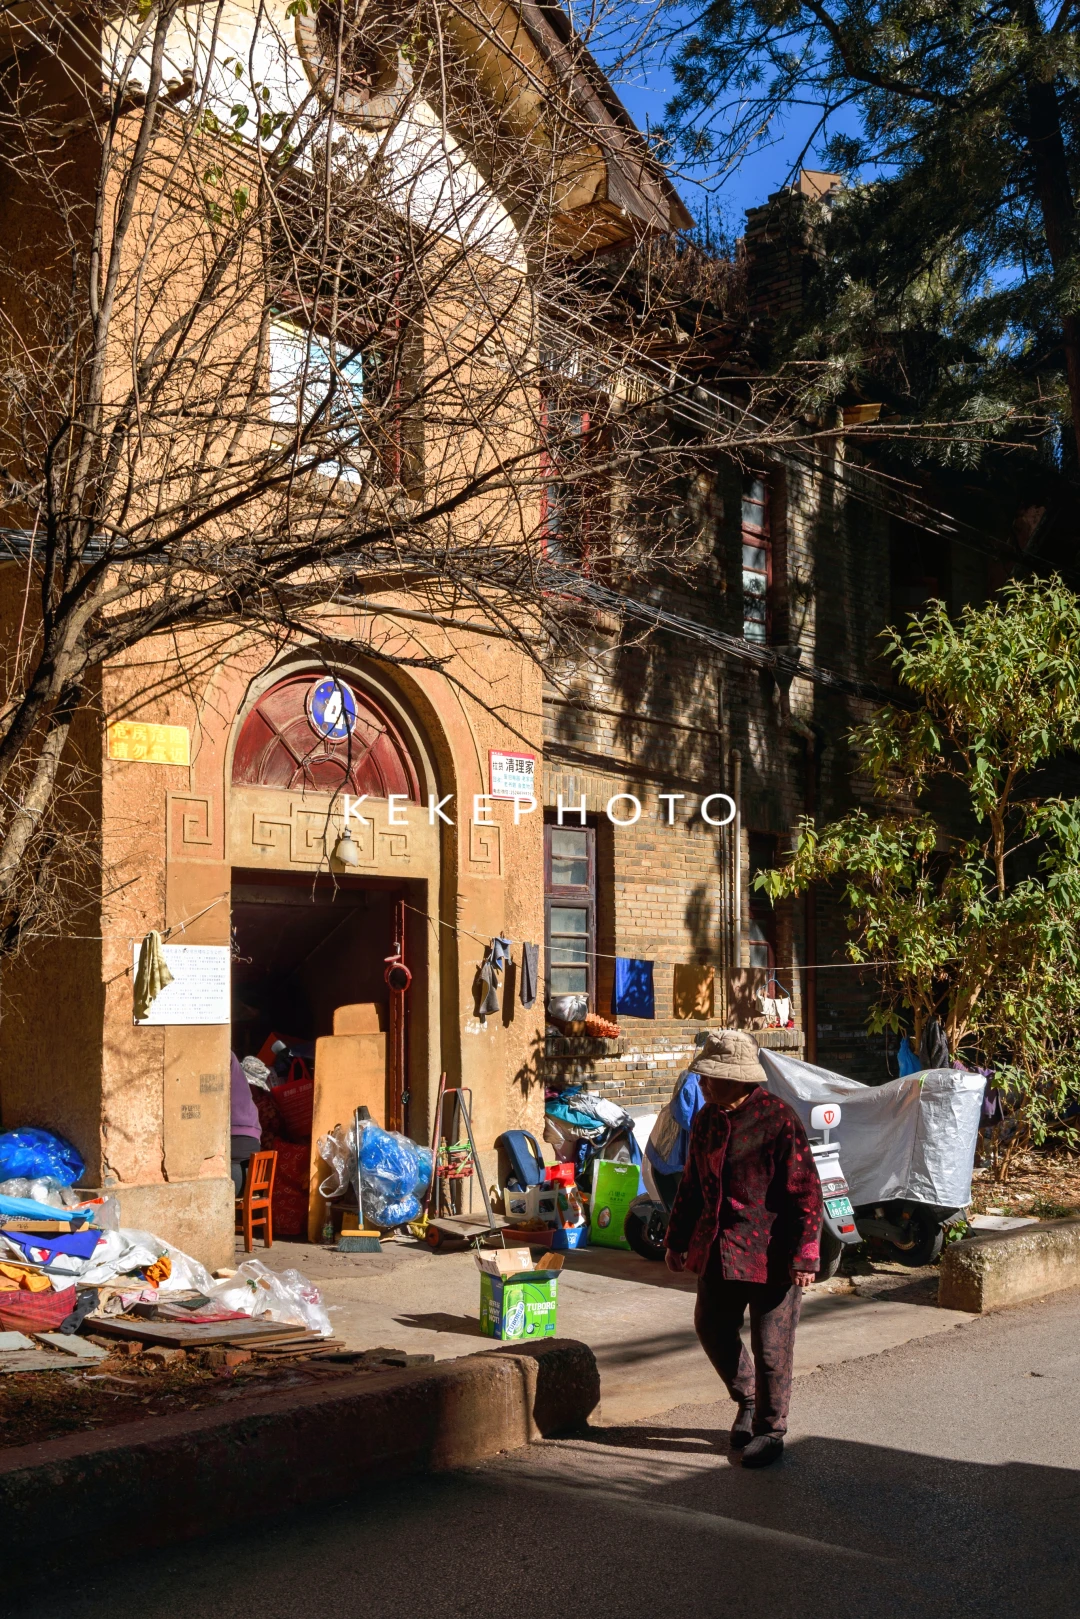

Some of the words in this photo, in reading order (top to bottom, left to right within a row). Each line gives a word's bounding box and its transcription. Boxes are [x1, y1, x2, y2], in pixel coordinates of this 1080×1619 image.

[112, 722, 185, 744] 危房危险
[112, 741, 185, 763] 请勿靠近
[526, 1300, 555, 1312] TUBORG
[506, 1303, 525, 1334] TUBORG
